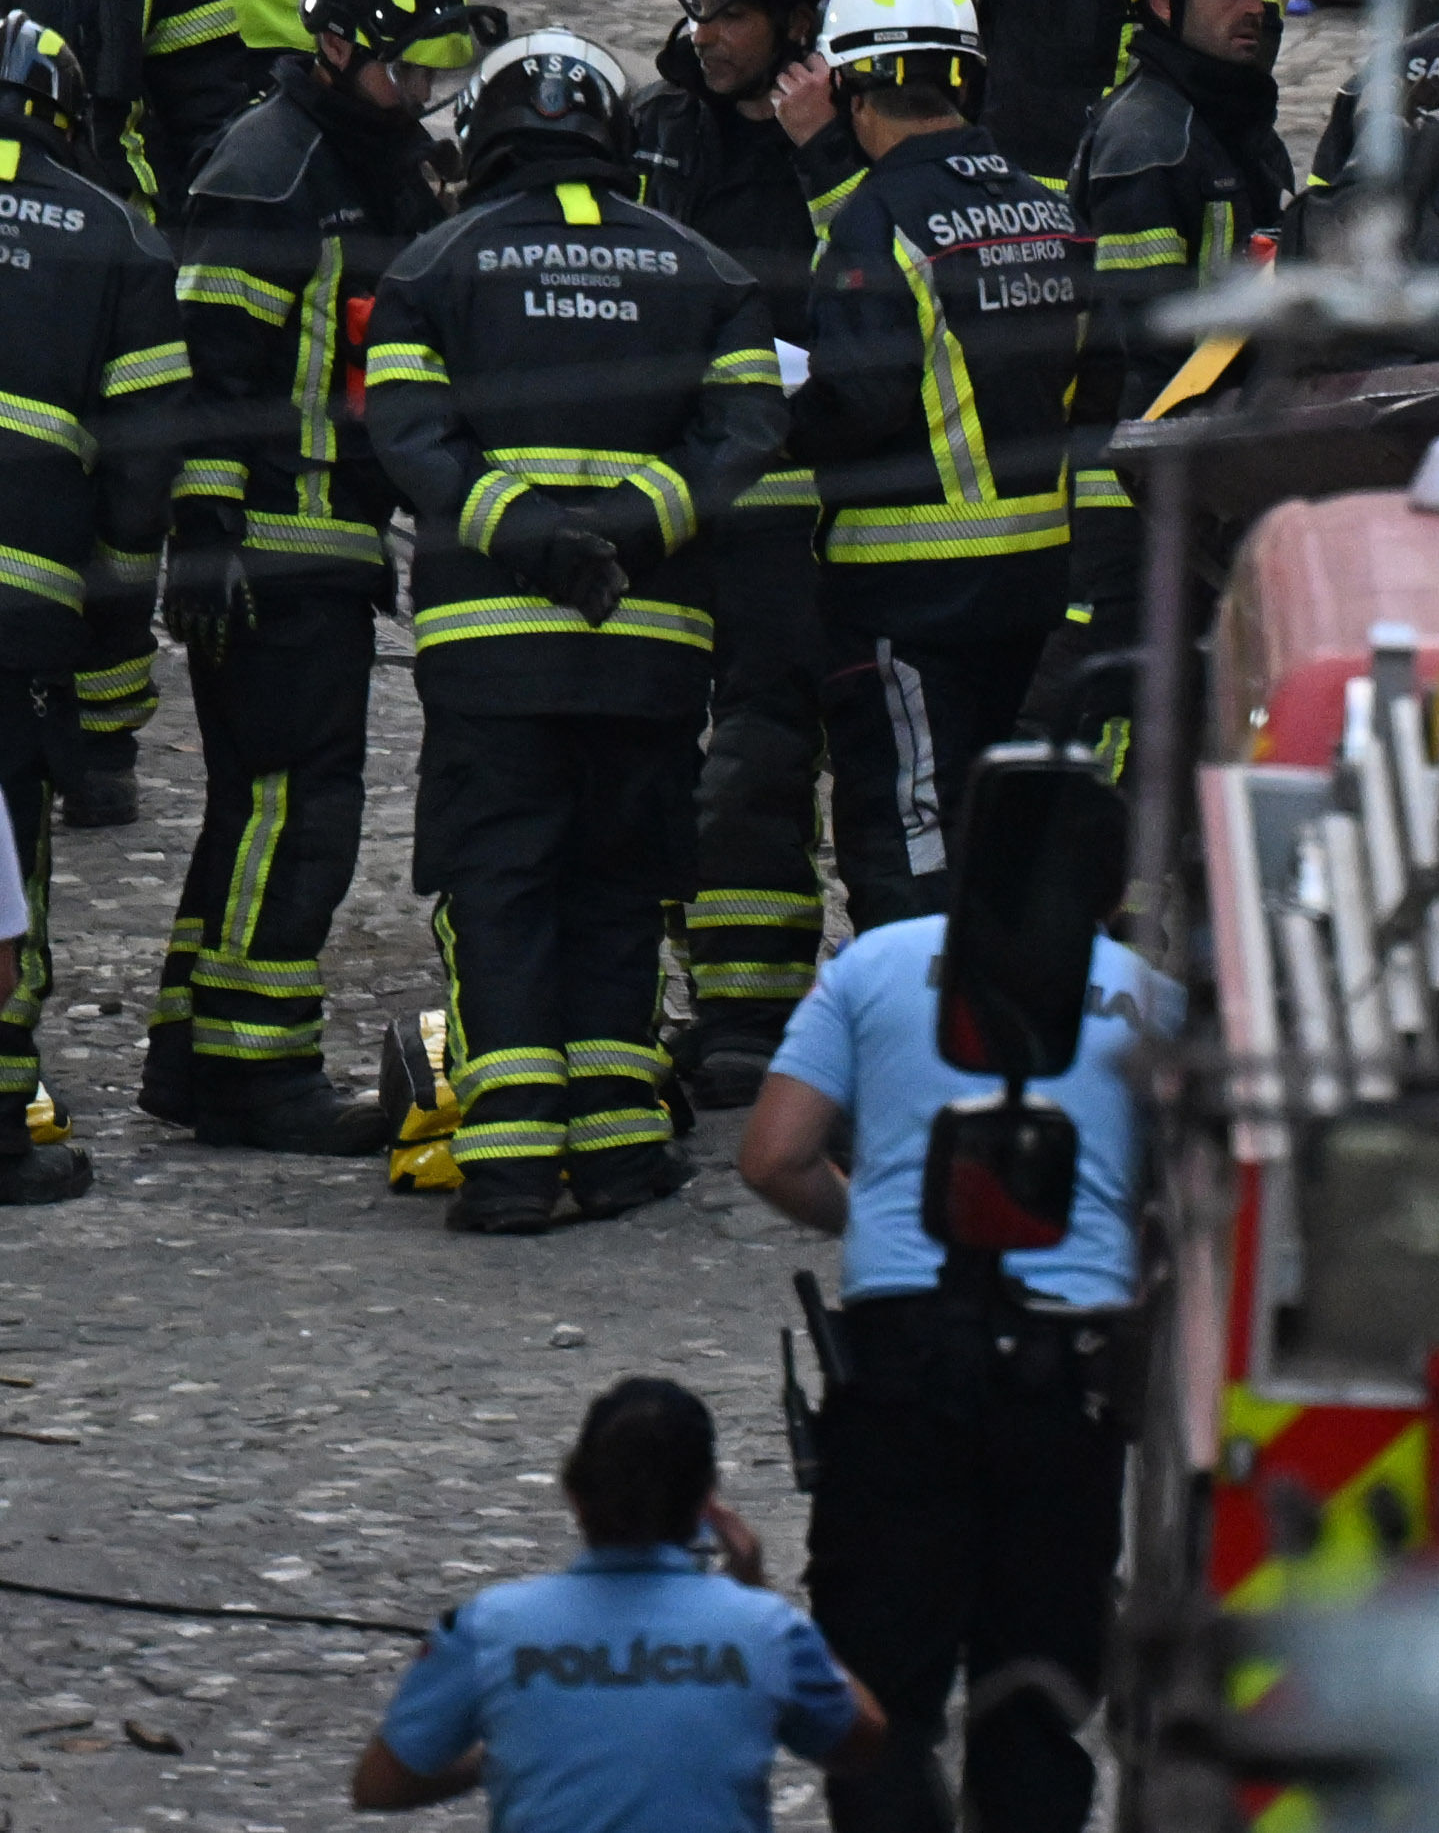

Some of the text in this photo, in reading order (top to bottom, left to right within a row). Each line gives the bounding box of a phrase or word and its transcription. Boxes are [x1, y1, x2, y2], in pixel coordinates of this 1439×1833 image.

[522, 54, 586, 83] RSB
[927, 200, 1077, 247] SAPADORES
[477, 243, 679, 276] SAPADORES
[978, 240, 1067, 268] BOMBEIROS
[540, 272, 622, 288] BOMBEIROS
[977, 272, 1075, 312] Lisboa
[524, 289, 639, 322] Lisboa
[513, 1633, 753, 1691] POLÍCIA
